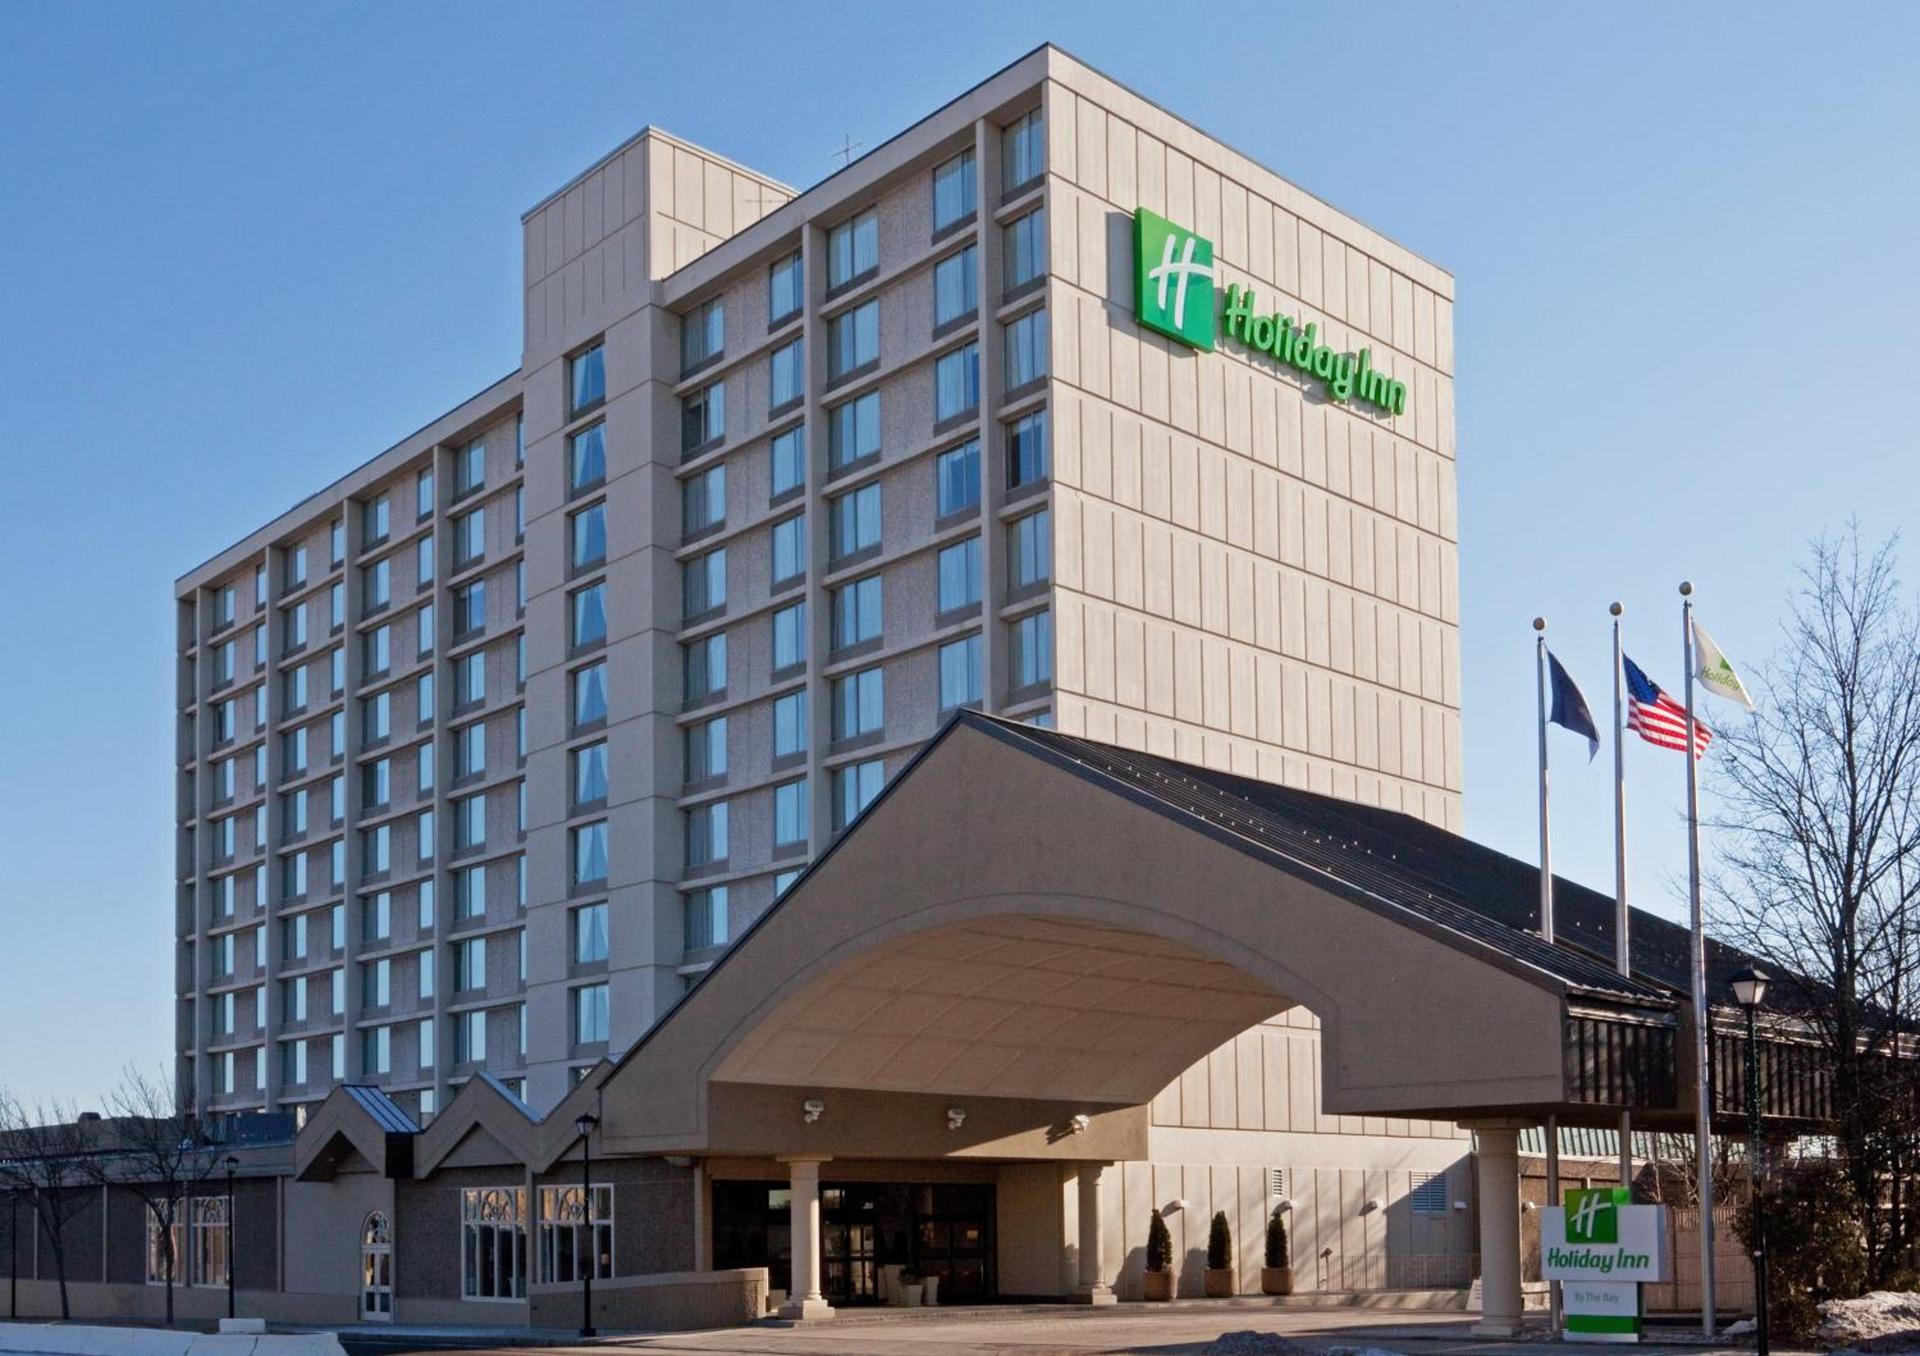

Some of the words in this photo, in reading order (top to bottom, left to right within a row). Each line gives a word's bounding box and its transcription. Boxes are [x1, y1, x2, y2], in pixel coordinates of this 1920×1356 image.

[1223, 283, 1355, 404] Holiday
[1356, 348, 1406, 415] Inn
[1547, 1247, 1614, 1274] Holiday
[1617, 1247, 1650, 1269] Inn
[1586, 1291, 1601, 1301] The
